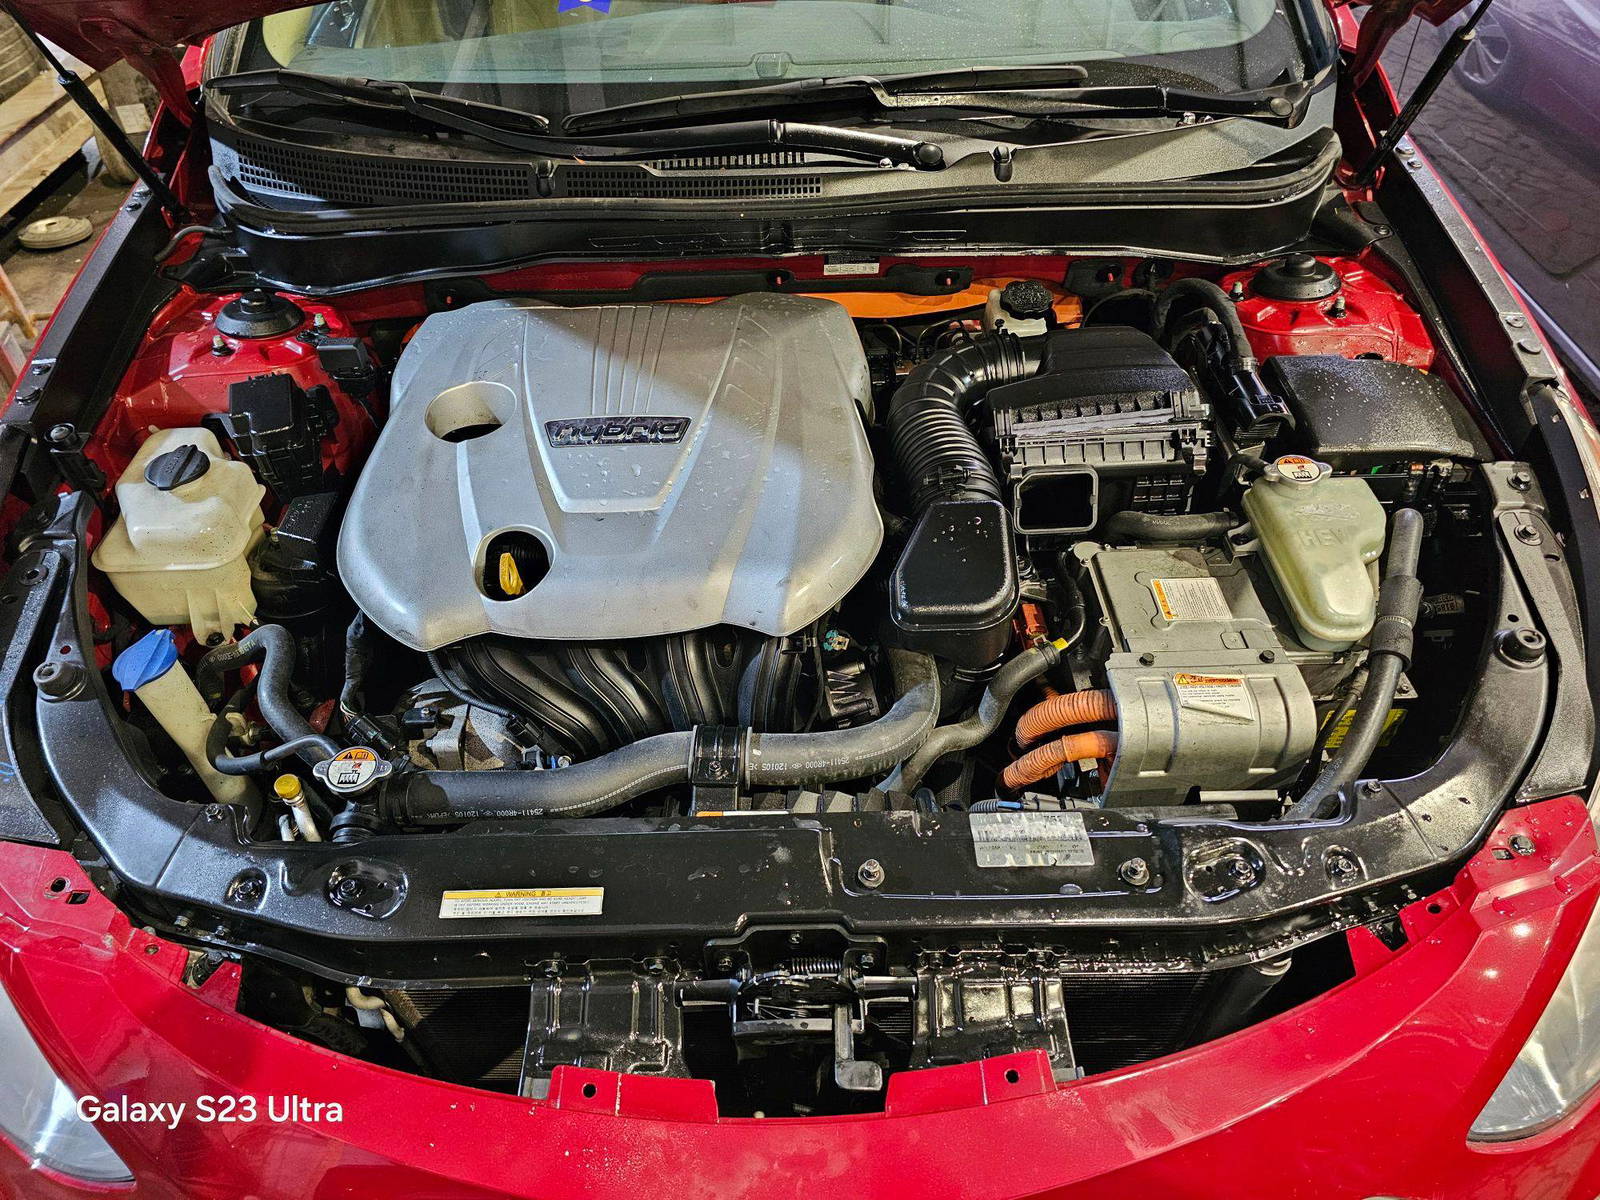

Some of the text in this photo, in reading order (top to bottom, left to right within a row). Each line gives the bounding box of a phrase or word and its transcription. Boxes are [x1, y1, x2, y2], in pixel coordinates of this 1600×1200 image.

[805, 756, 850, 769] 25411-4R000
[496, 808, 543, 817] 25411-4R000
[505, 890, 537, 898] WARNING
